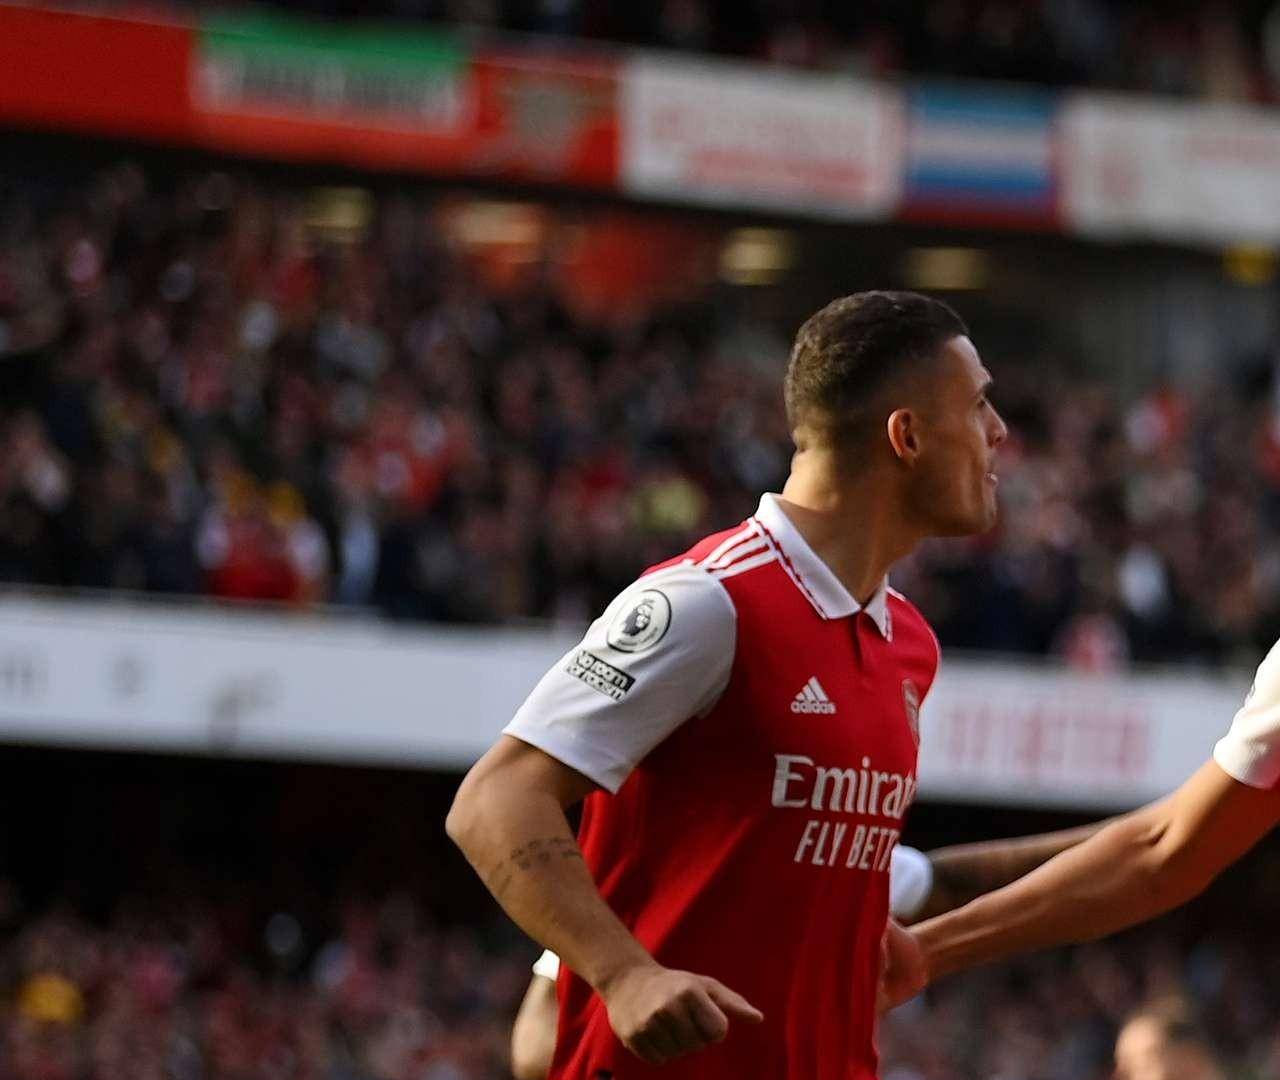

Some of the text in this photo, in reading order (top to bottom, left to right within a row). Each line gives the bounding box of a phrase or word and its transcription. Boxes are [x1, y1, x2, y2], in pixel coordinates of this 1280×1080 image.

[791, 700, 837, 715] adidas
[793, 820, 901, 873] FLY BETT
